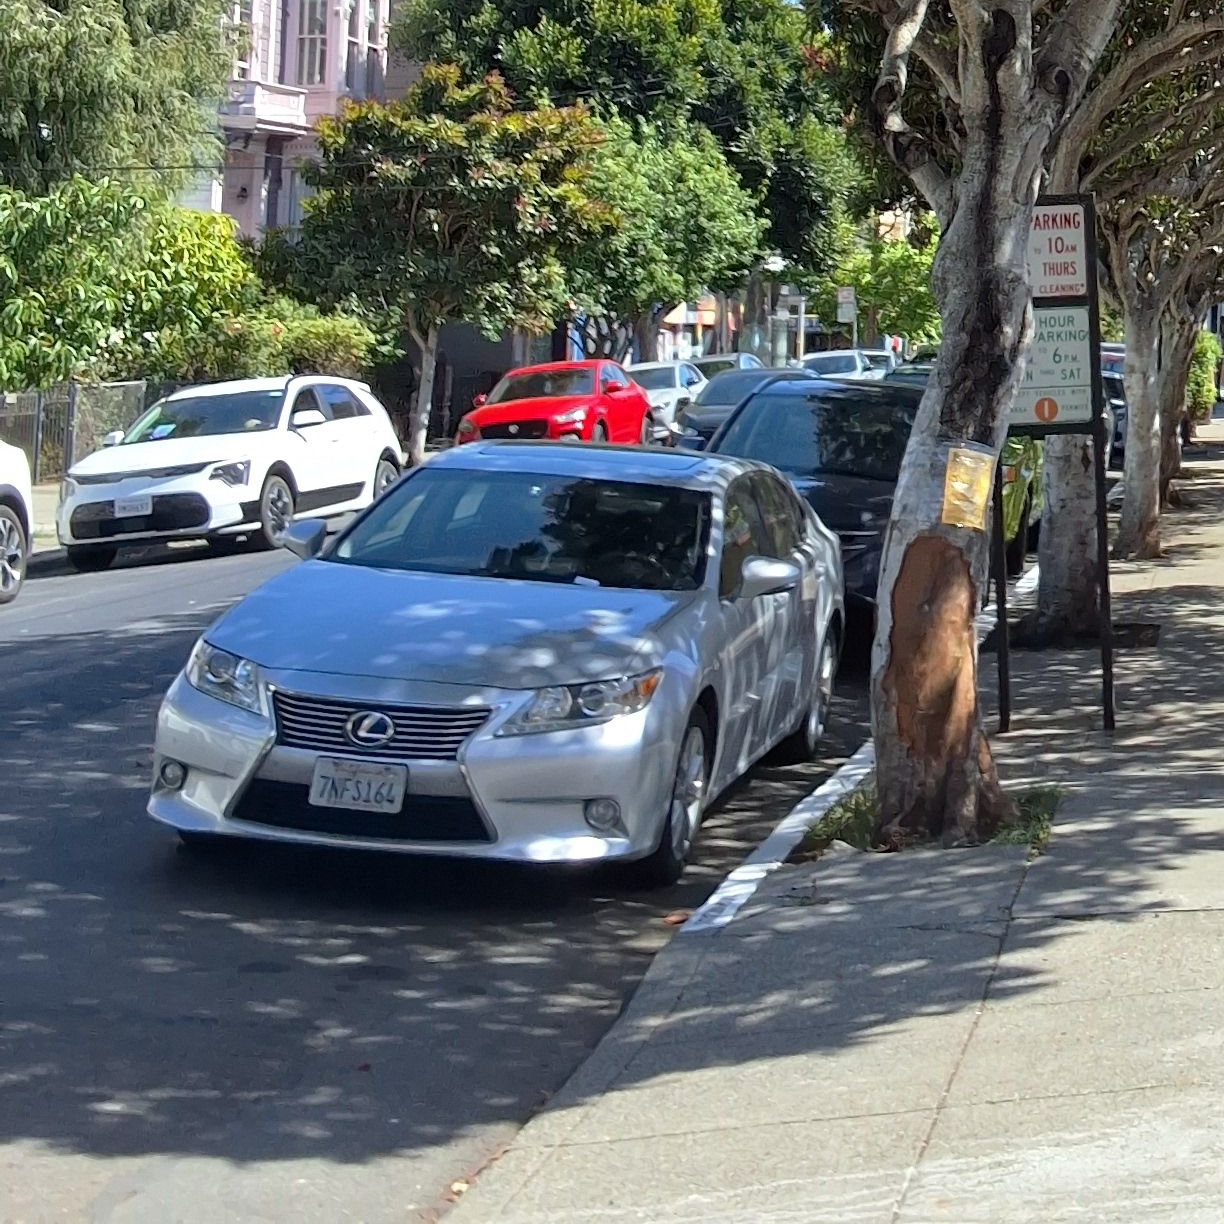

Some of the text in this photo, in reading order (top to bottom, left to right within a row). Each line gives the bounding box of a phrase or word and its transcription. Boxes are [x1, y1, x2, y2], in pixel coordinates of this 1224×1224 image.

[1030, 213, 1080, 230] ARKING
[1042, 261, 1076, 276] THURS
[1039, 315, 1075, 328] HOUR
[1034, 329, 1087, 343] ARKING
[1053, 347, 1062, 363] 6
[1060, 368, 1082, 380] SAT
